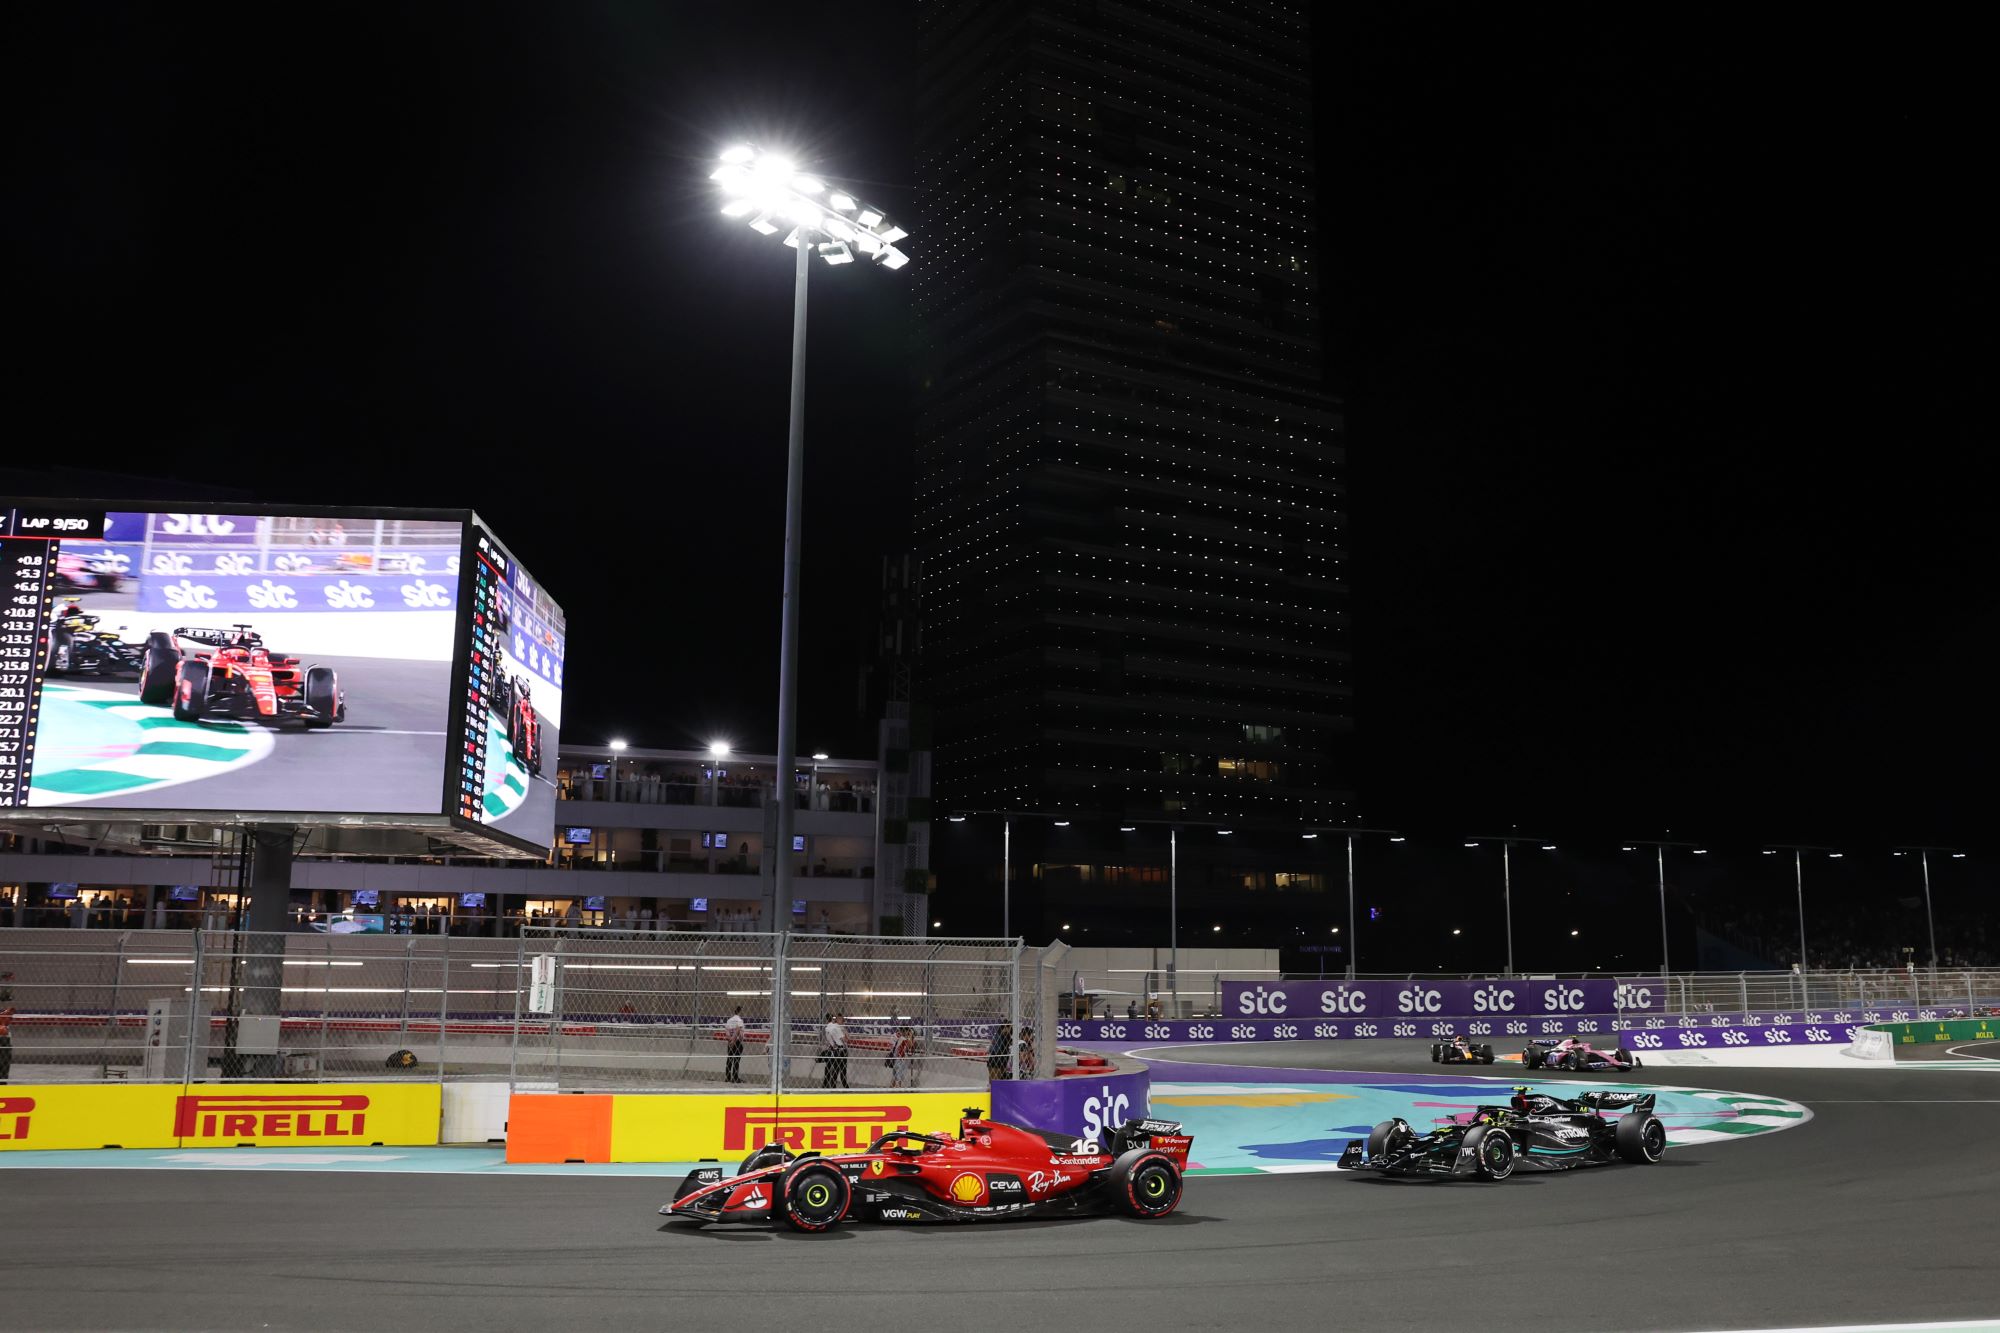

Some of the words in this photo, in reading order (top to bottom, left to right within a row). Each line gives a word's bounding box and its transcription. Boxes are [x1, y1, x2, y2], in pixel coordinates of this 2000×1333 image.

[22, 518, 49, 528] LAP
[53, 519, 89, 530] 9/50
[18, 556, 42, 565] +0.8
[152, 551, 193, 575] stc
[215, 551, 254, 575] stc
[16, 569, 40, 578] +5.3
[14, 582, 39, 591] +6.6
[163, 579, 218, 609] stc
[246, 579, 298, 609] stc
[324, 579, 374, 608] stc
[401, 579, 451, 607] stc
[12, 595, 37, 604] +6.8
[4, 608, 36, 617] +10.8
[2, 621, 34, 630] +13.3
[0, 635, 32, 644] +13.5
[0, 648, 30, 657] +15.3
[0, 675, 27, 684] 17.7
[1240, 986, 1287, 1014] stc
[1321, 986, 1366, 1013] stc
[1398, 986, 1441, 1012] stc
[1474, 985, 1515, 1011] stc
[1544, 984, 1584, 1010] stc
[1613, 984, 1651, 1009] stc
[1056, 1023, 1081, 1038] stc
[1100, 1023, 1126, 1038] stc
[1145, 1024, 1170, 1038] stc
[1189, 1024, 1214, 1038] stc
[1231, 1024, 1256, 1038] stc
[1273, 1024, 1298, 1038] stc
[1314, 1023, 1338, 1037] stc
[1354, 1022, 1378, 1037] stc
[1394, 1022, 1416, 1036] stc
[1432, 1021, 1454, 1035] stc
[1469, 1021, 1491, 1034] stc
[1506, 1020, 1527, 1034] stc
[1542, 1019, 1563, 1033] stc
[1577, 1019, 1598, 1032] stc
[1646, 1017, 1665, 1029] stc
[1711, 1016, 1730, 1027] stc
[1774, 1014, 1792, 1025] stc
[1834, 1011, 1851, 1023] stc
[1892, 1010, 1909, 1022] stc
[1920, 1009, 1936, 1021] stc
[1633, 1032, 1662, 1047] stc
[1679, 1030, 1707, 1046] stc
[1722, 1029, 1749, 1044] stc
[1764, 1028, 1791, 1043] stc
[1805, 1027, 1831, 1041] stc
[1976, 1031, 1994, 1039] ROLEX
[1588, 1092, 1638, 1100] PERONAS
[174, 1095, 369, 1137] PIRELLI
[1083, 1086, 1129, 1139] stc
[724, 1106, 912, 1150] PIRELLI
[1071, 1139, 1099, 1155] 16
[1461, 1147, 1476, 1157] IWC
[1059, 1156, 1100, 1164] Santander
[698, 1171, 719, 1179] aws
[1028, 1170, 1071, 1192] Ray-Ban
